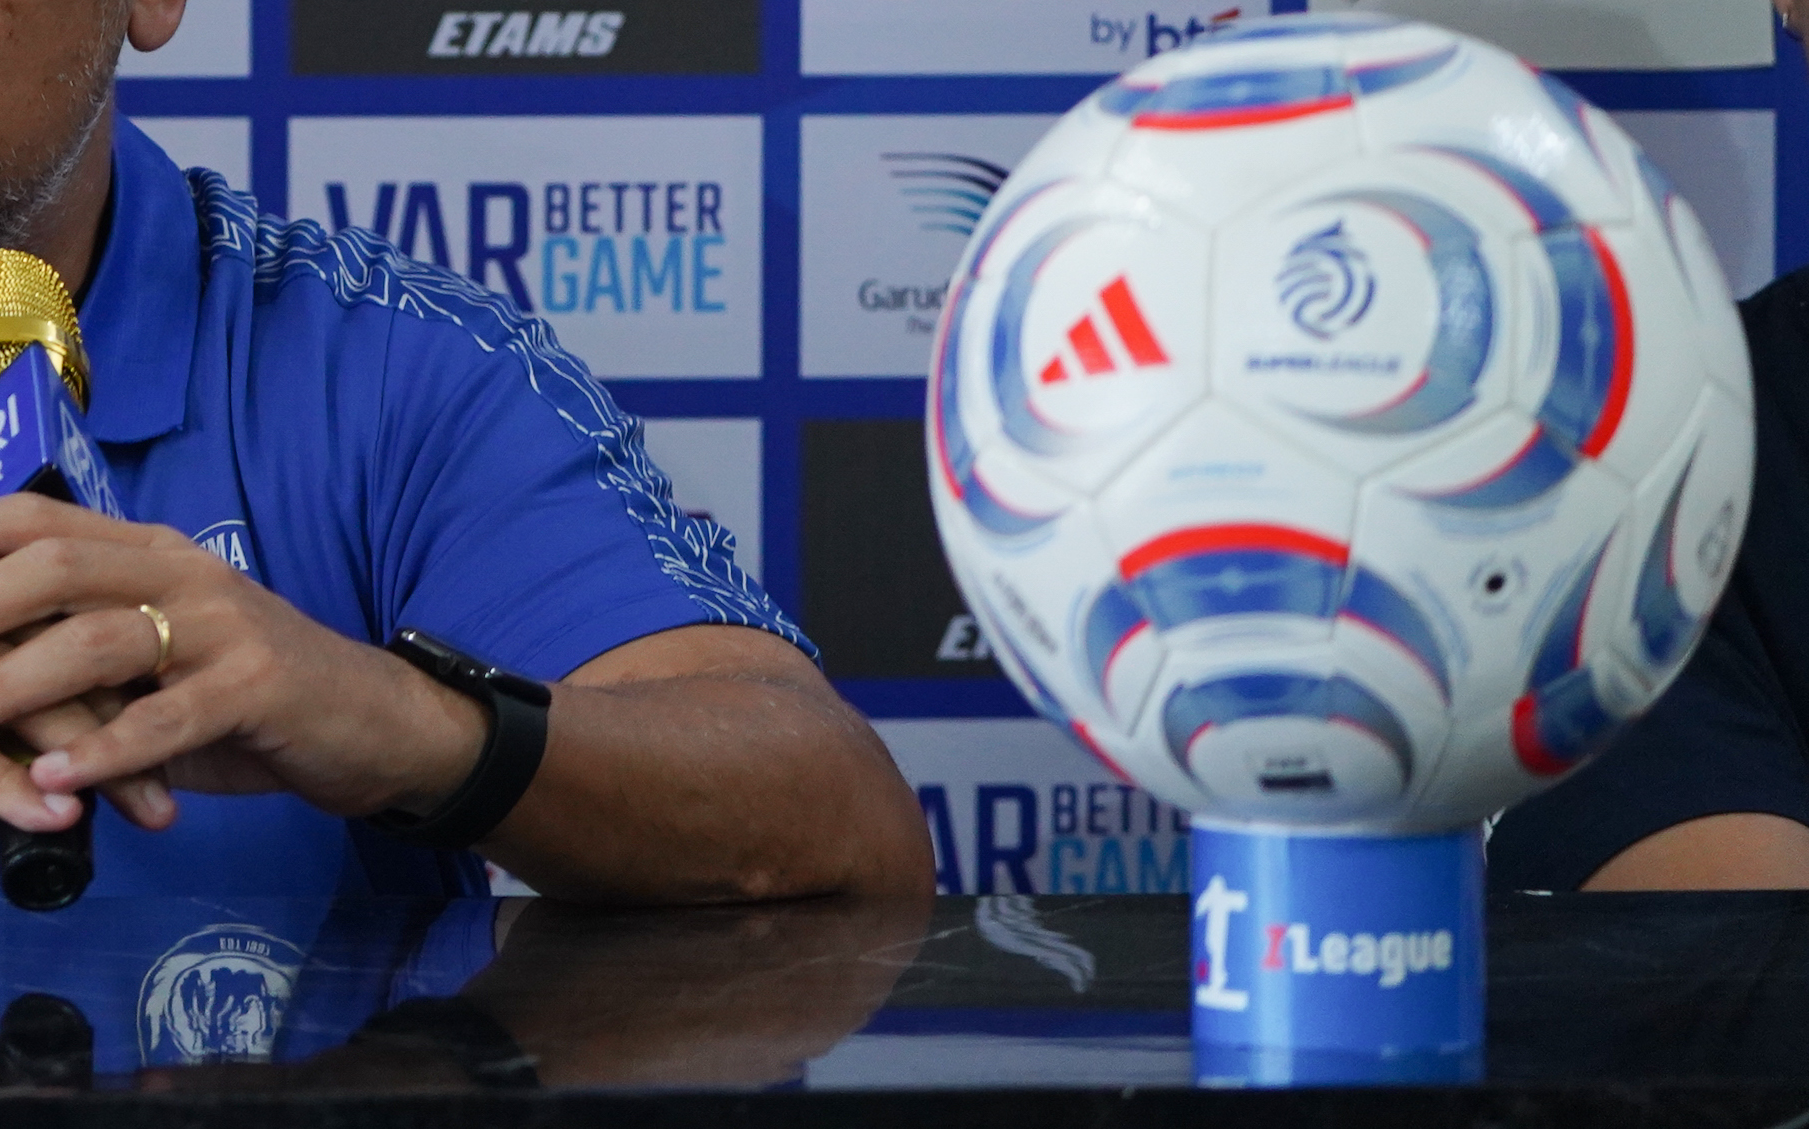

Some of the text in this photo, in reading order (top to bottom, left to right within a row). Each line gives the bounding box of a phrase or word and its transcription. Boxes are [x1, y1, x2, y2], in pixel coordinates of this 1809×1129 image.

[428, 11, 625, 57] ETAMS
[1089, 13, 1137, 52] by
[543, 182, 722, 234] BETTER
[541, 234, 727, 314] GAME
